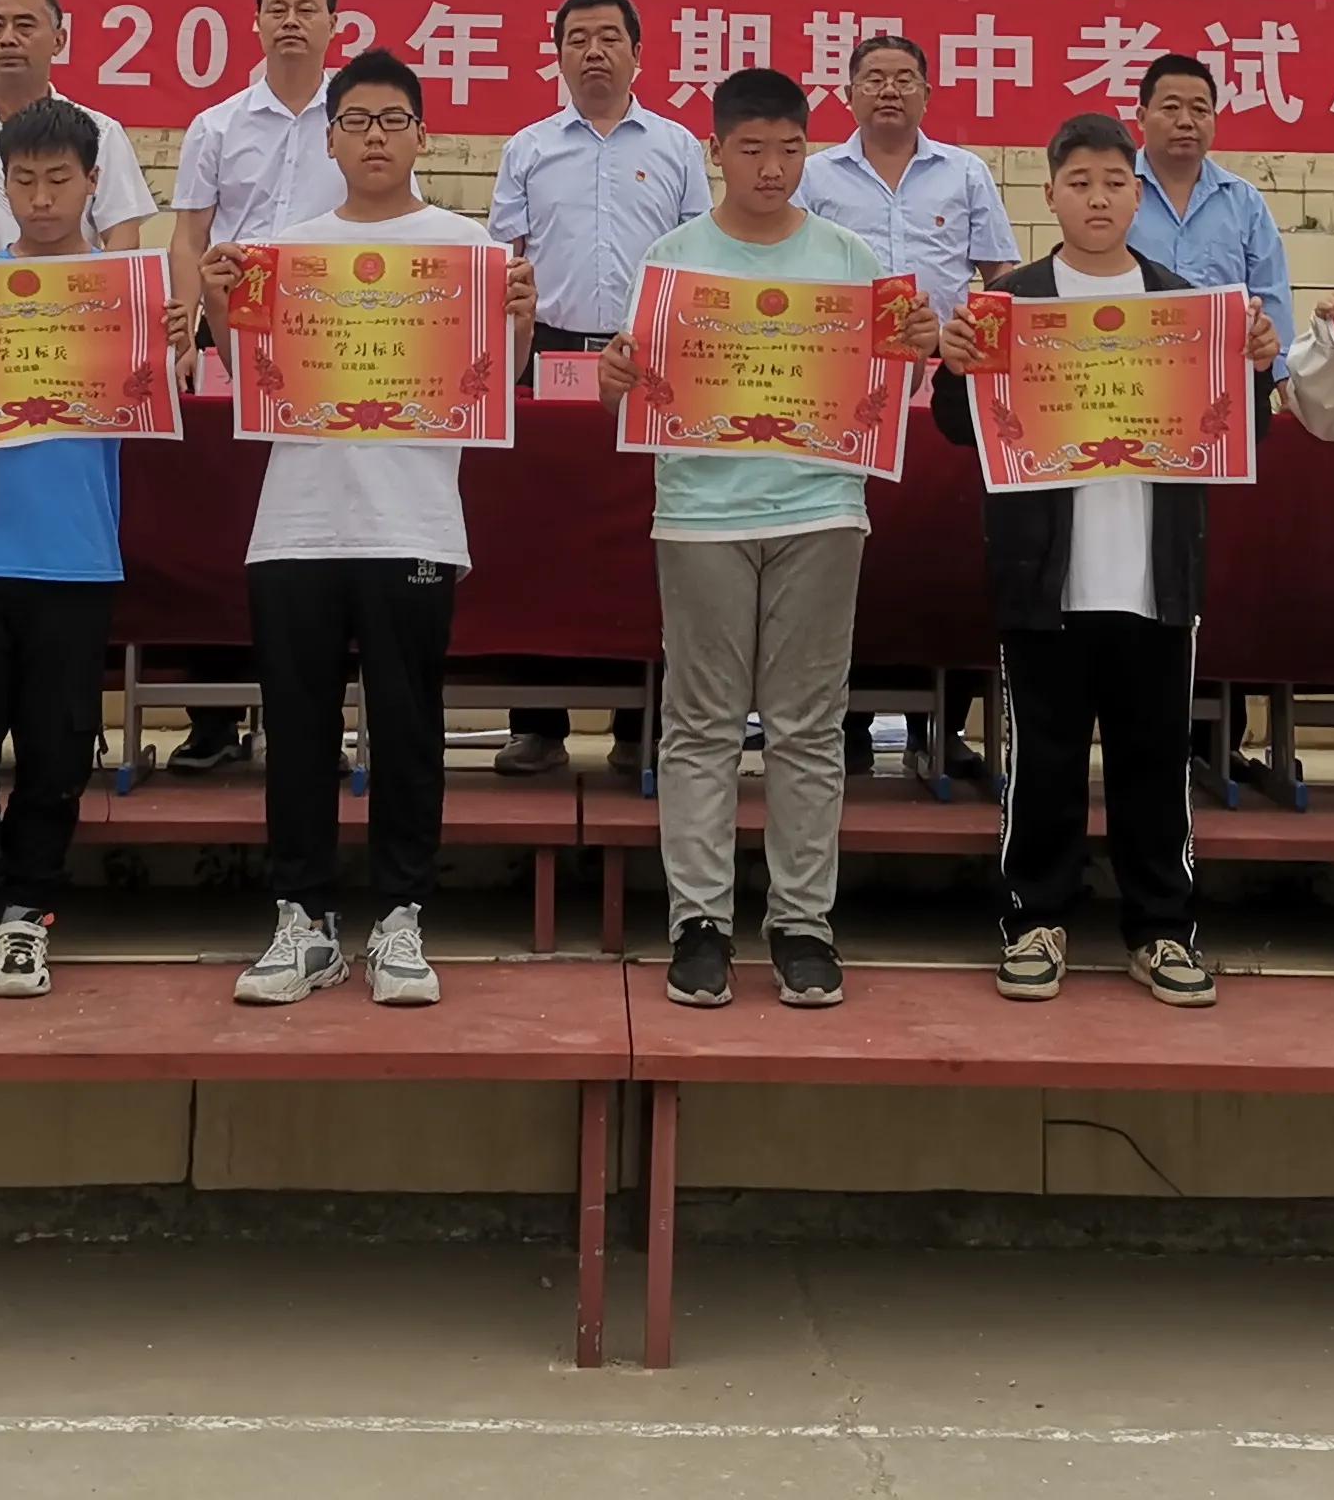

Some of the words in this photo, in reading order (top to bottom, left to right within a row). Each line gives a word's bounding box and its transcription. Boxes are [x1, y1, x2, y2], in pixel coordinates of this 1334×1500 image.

[335, 342, 406, 357] 学习标兵
[732, 363, 803, 377] 学习标兵
[1075, 382, 1145, 397] 学习标兵
